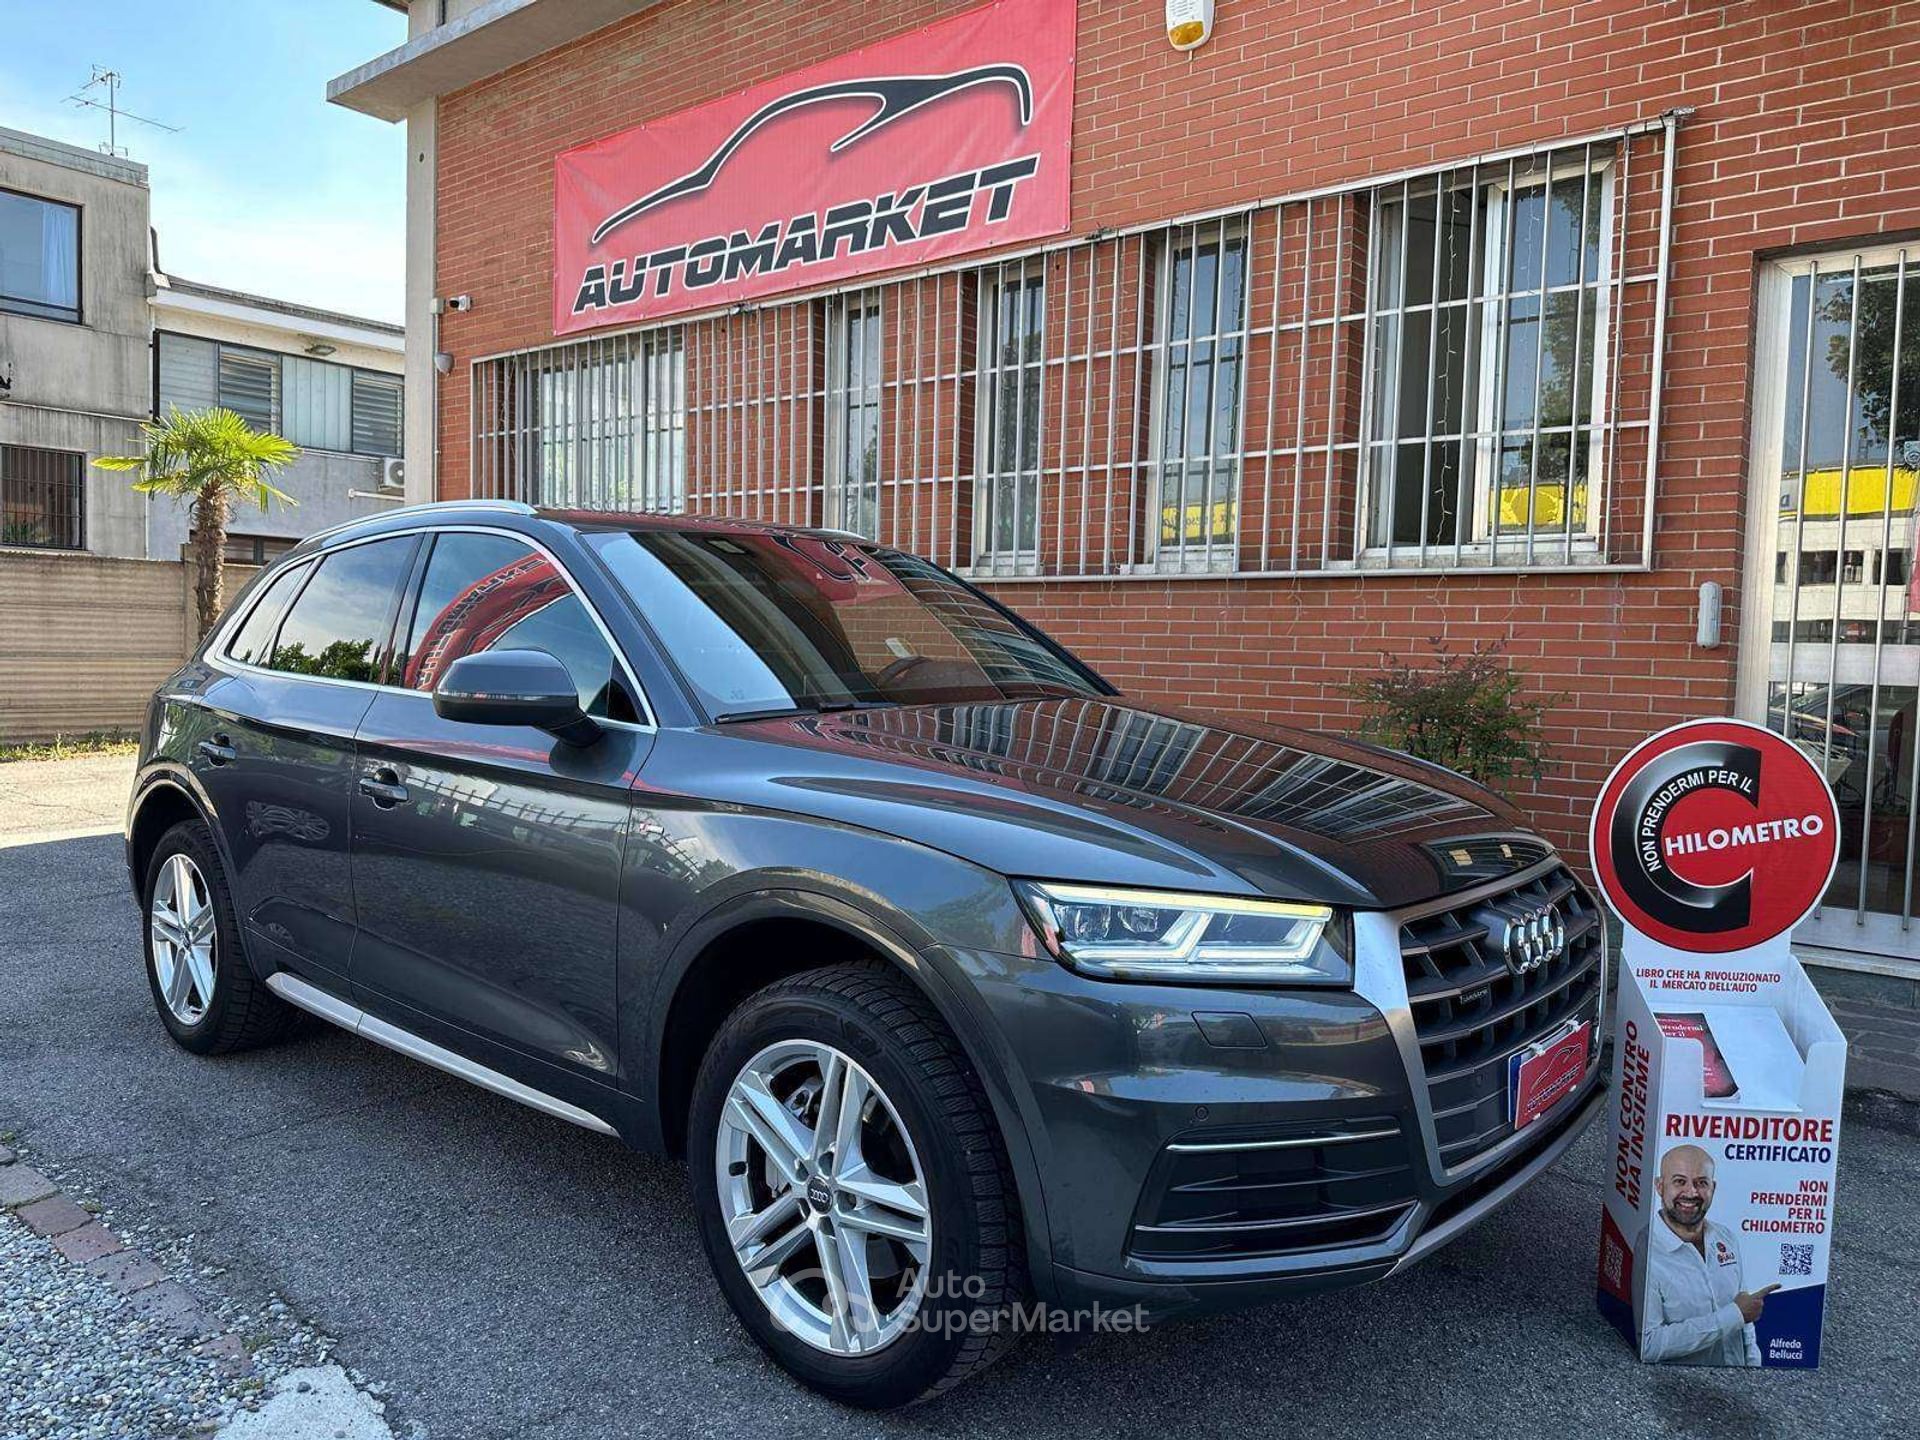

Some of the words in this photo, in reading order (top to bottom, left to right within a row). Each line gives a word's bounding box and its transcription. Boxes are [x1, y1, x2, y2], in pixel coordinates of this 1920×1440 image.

[572, 153, 1041, 314] AUTOMARKET
[1708, 770, 1739, 787] PER
[1740, 776, 1753, 794] IL
[1641, 771, 1705, 837] PRENDERMI
[1641, 840, 1662, 872] NON
[1636, 968, 1664, 978] LIBRO
[1666, 969, 1685, 980] CHE
[1687, 970, 1701, 980] HA
[1705, 970, 1781, 983] RIVOLUZIONATO
[1650, 980, 1658, 989] IL
[1662, 980, 1706, 991] MERCATO
[1709, 981, 1757, 993] DELL'AUTO
[1620, 1020, 1638, 1131] CONTRO
[1631, 1044, 1650, 1161] INSIEME
[1665, 1114, 1833, 1142] RIVENDITORE
[1725, 1144, 1831, 1163] CERTIFICATO
[1616, 1135, 1631, 1198] NON
[1626, 1166, 1642, 1210] MA
[1799, 1180, 1828, 1193] NON
[1751, 1192, 1828, 1207] PRENDERMI
[1788, 1208, 1812, 1220] PER
[1816, 1209, 1827, 1221] IL
[1741, 1219, 1825, 1235] CHILOMETRO
[1770, 1337, 1802, 1348] Alfredo
[1769, 1349, 1803, 1360] Bellucci
